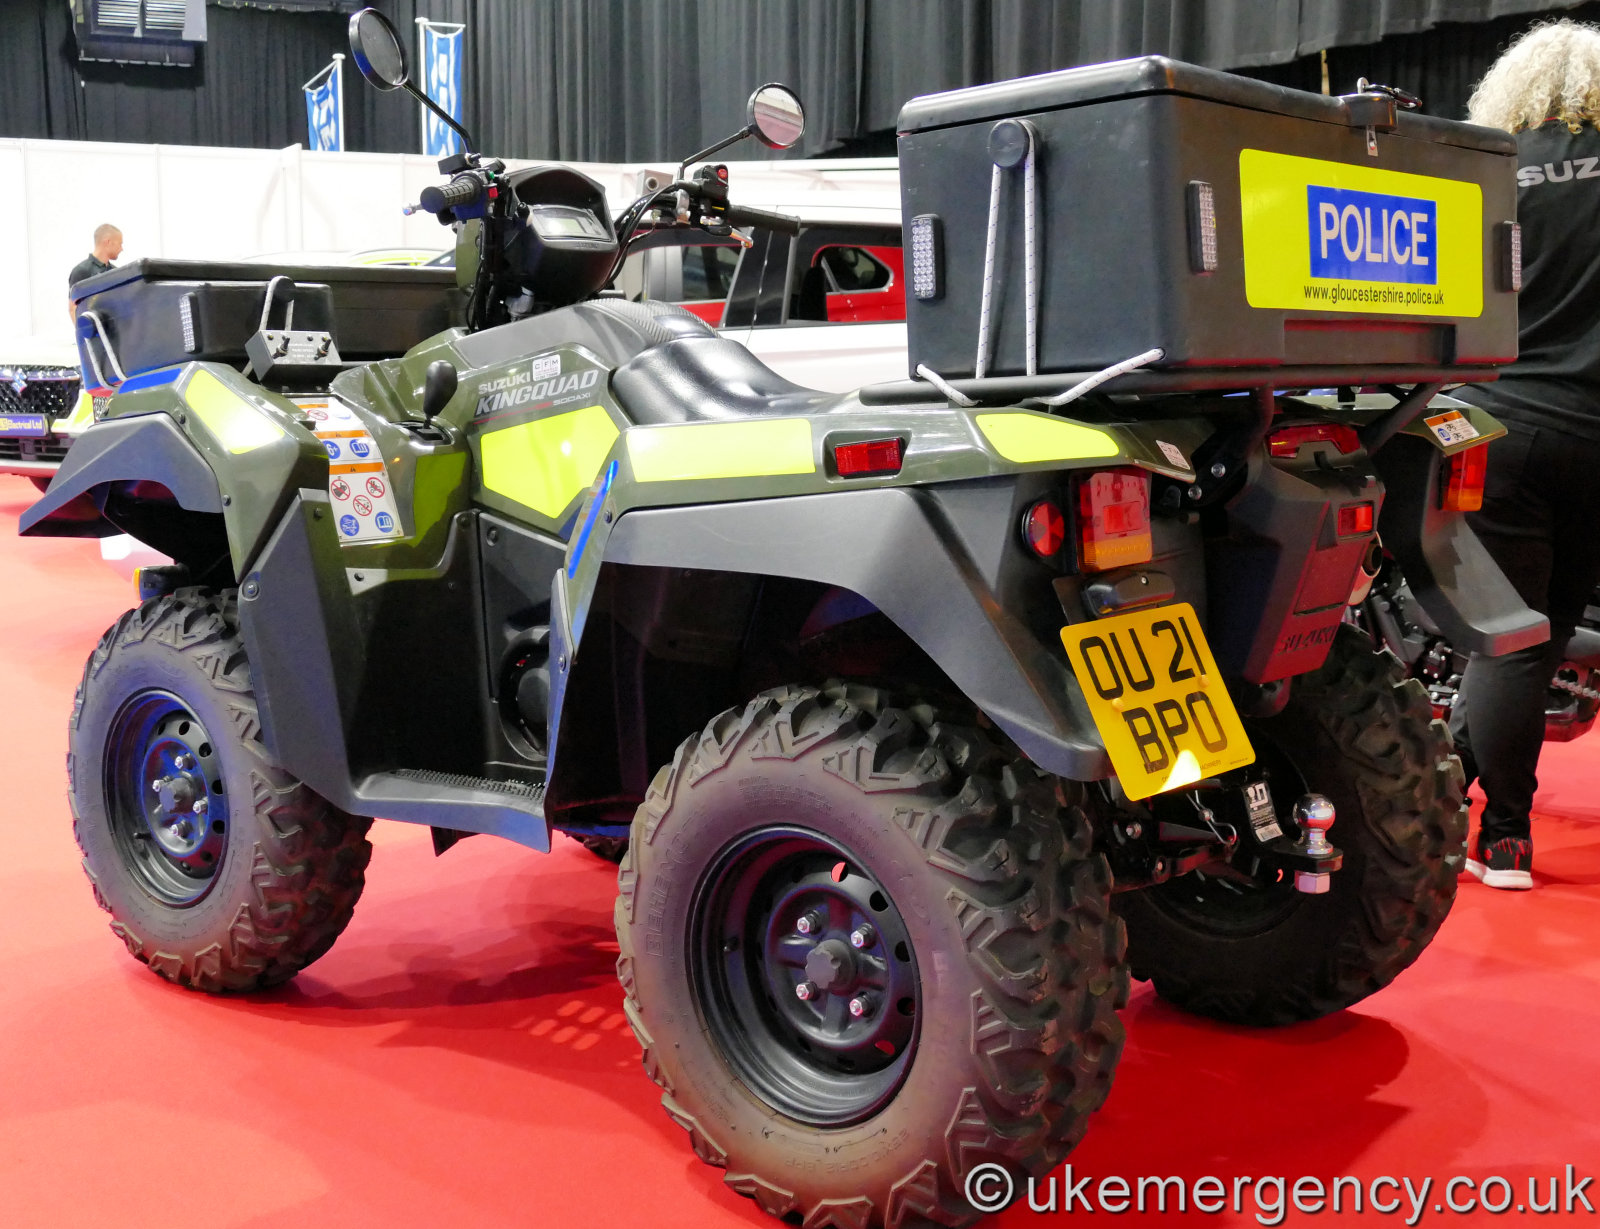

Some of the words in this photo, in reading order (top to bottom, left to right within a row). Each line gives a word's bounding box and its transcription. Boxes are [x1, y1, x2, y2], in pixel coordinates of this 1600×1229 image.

[1516, 156, 1600, 187] SUZ
[1319, 202, 1429, 266] POLICE
[1304, 284, 1444, 306] www.gloucestershire.police.uk
[476, 369, 599, 416] KINGQUAD
[478, 371, 531, 395] SUZUKI
[1079, 616, 1206, 700] OU21
[1121, 690, 1228, 775] BPO
